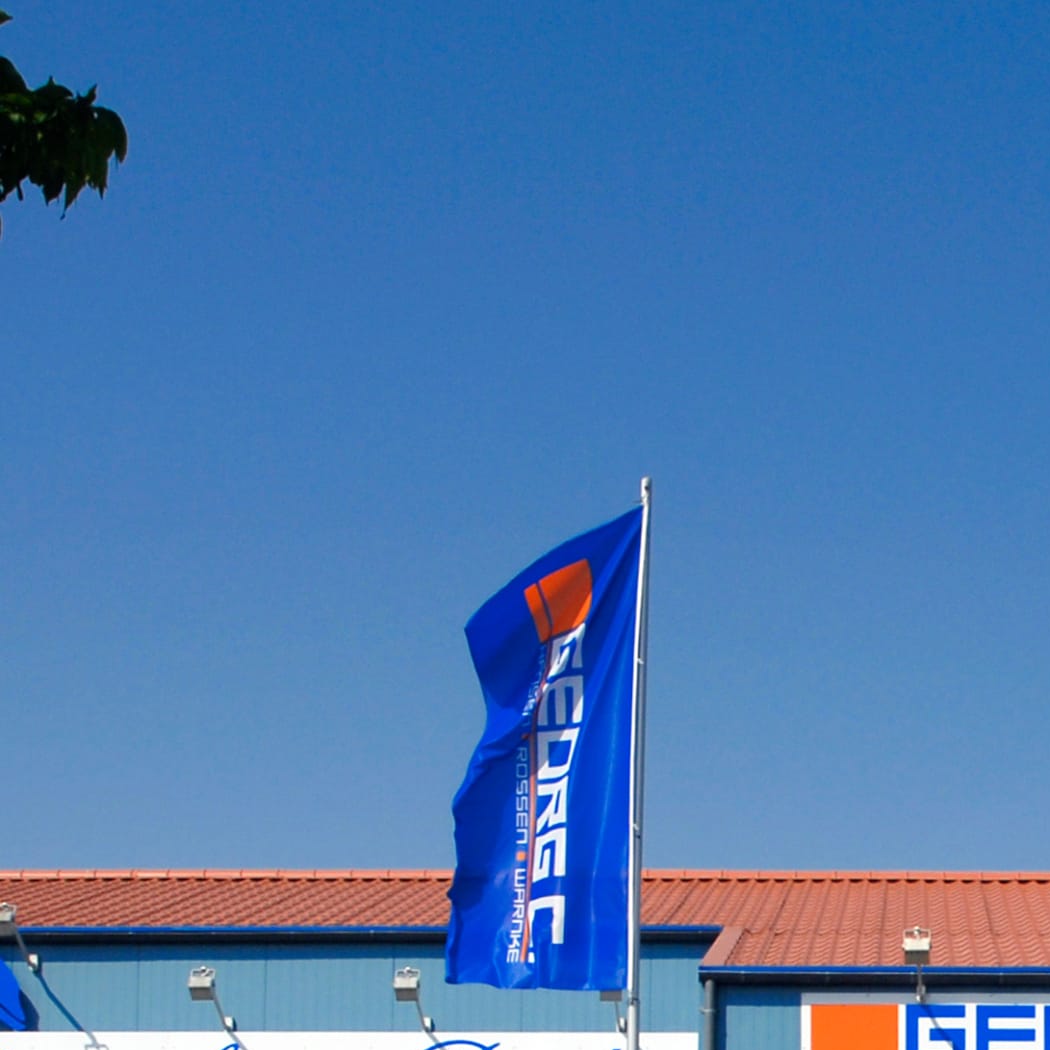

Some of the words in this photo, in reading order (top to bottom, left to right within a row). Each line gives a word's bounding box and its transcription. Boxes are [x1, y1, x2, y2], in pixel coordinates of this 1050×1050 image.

[515, 747, 529, 844] ROSSEN
[532, 622, 586, 883] GEORG
[506, 869, 526, 963] WARNKE
